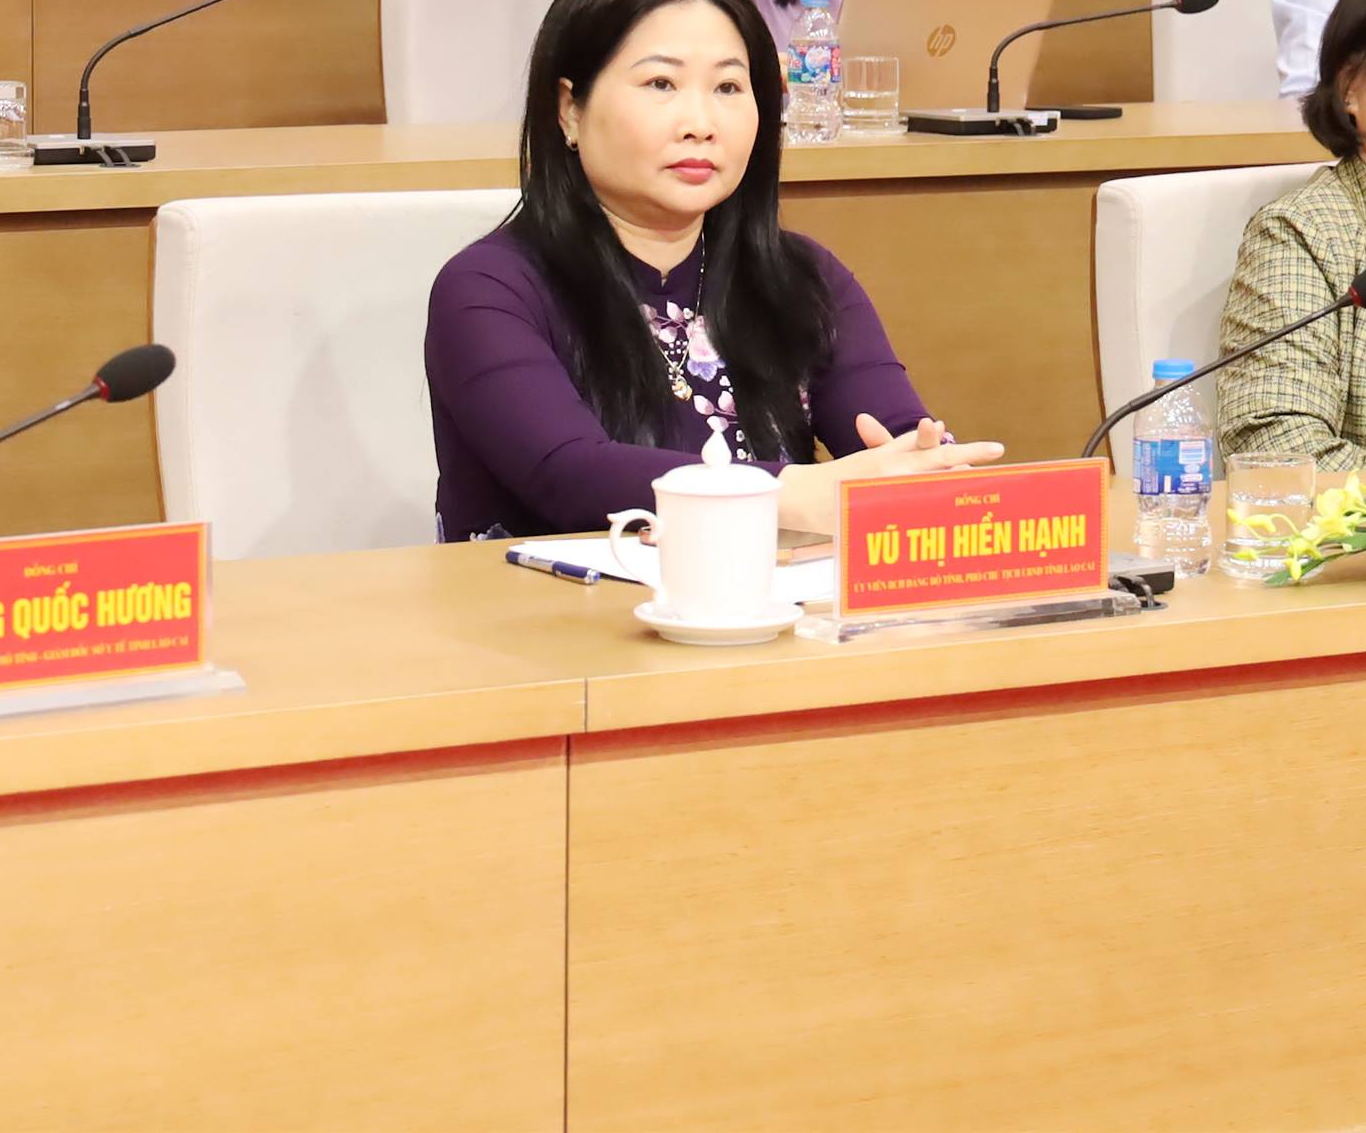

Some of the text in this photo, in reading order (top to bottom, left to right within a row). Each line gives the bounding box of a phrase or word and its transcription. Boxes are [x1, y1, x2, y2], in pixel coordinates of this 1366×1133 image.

[928, 24, 956, 57] hp
[867, 511, 1085, 567] VŨ THỊ HIỀN HẠNH
[13, 582, 89, 639] QUỐC
[97, 582, 192, 627] HƯƠNG
